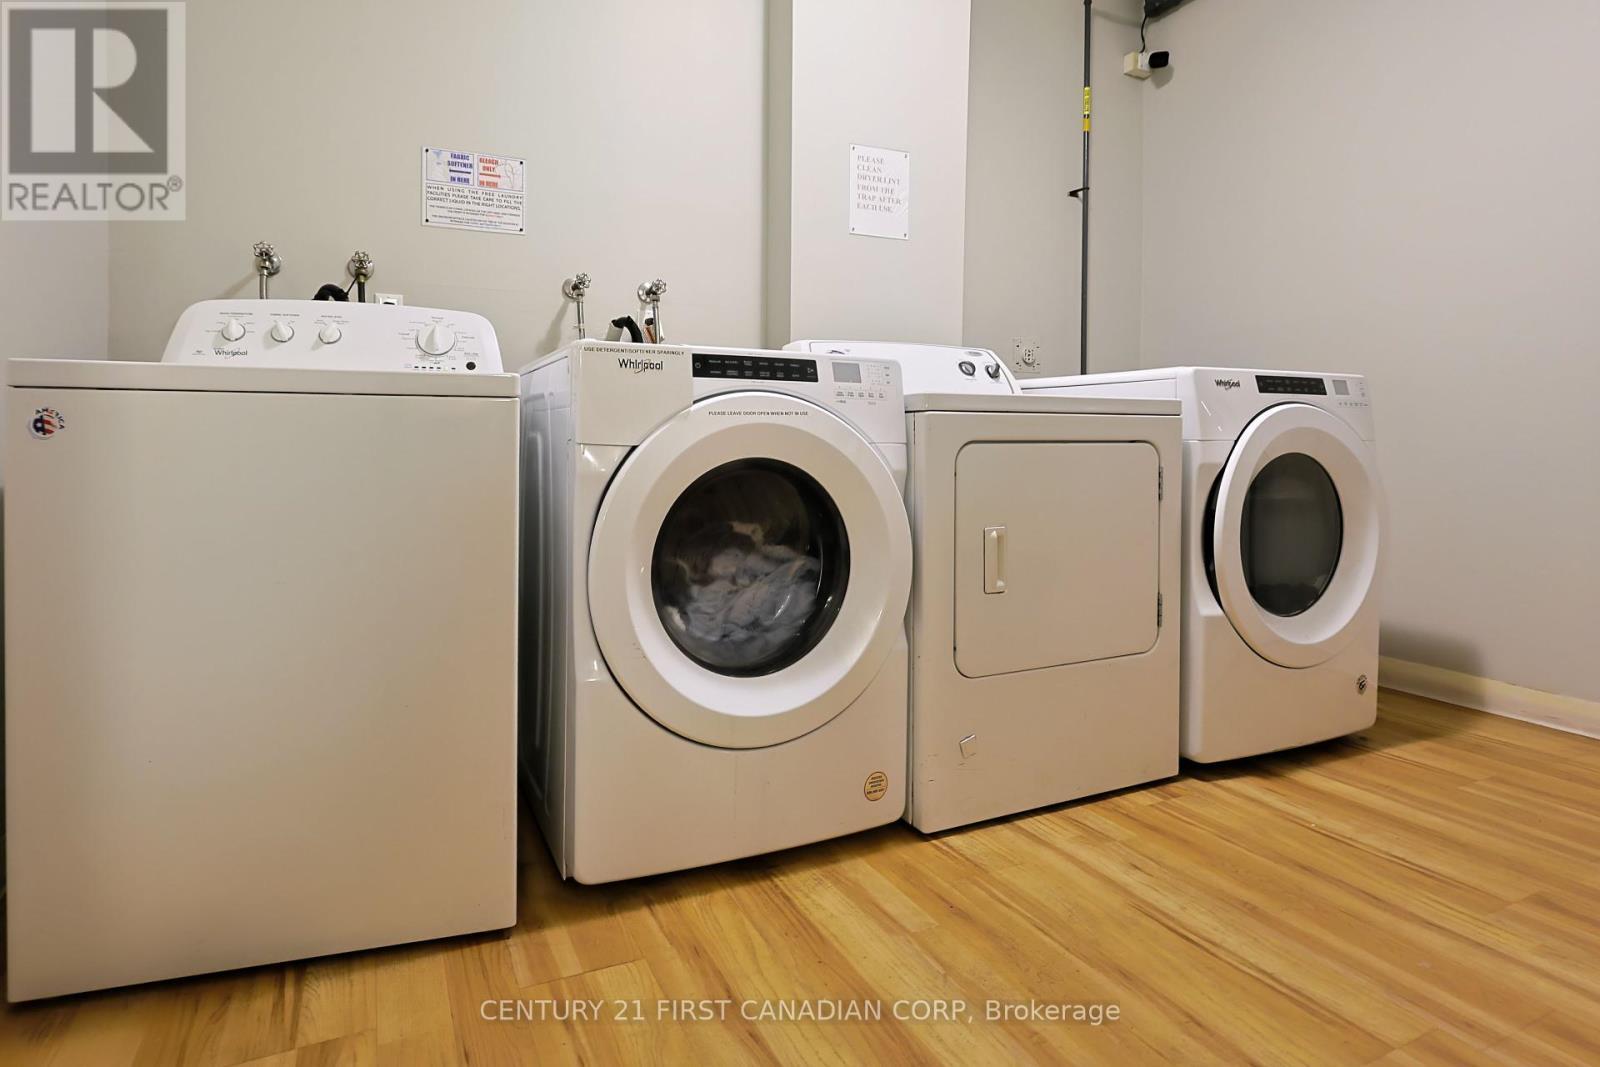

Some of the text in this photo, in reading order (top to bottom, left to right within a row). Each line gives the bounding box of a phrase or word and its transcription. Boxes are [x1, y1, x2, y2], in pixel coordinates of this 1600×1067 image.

[450, 152, 470, 161] FABRIC
[857, 154, 884, 165] PLEASE
[448, 160, 473, 169] SOFTENER
[480, 157, 499, 166] BLEACH
[857, 164, 882, 173] CLEAN
[857, 174, 882, 183] DRYER
[857, 184, 879, 192] FROM
[857, 193, 902, 205] TRAP AFTER
[214, 348, 248, 357] Whirlpool
[618, 358, 664, 373] Whirlpool
[1214, 378, 1241, 390] Whirlpool
